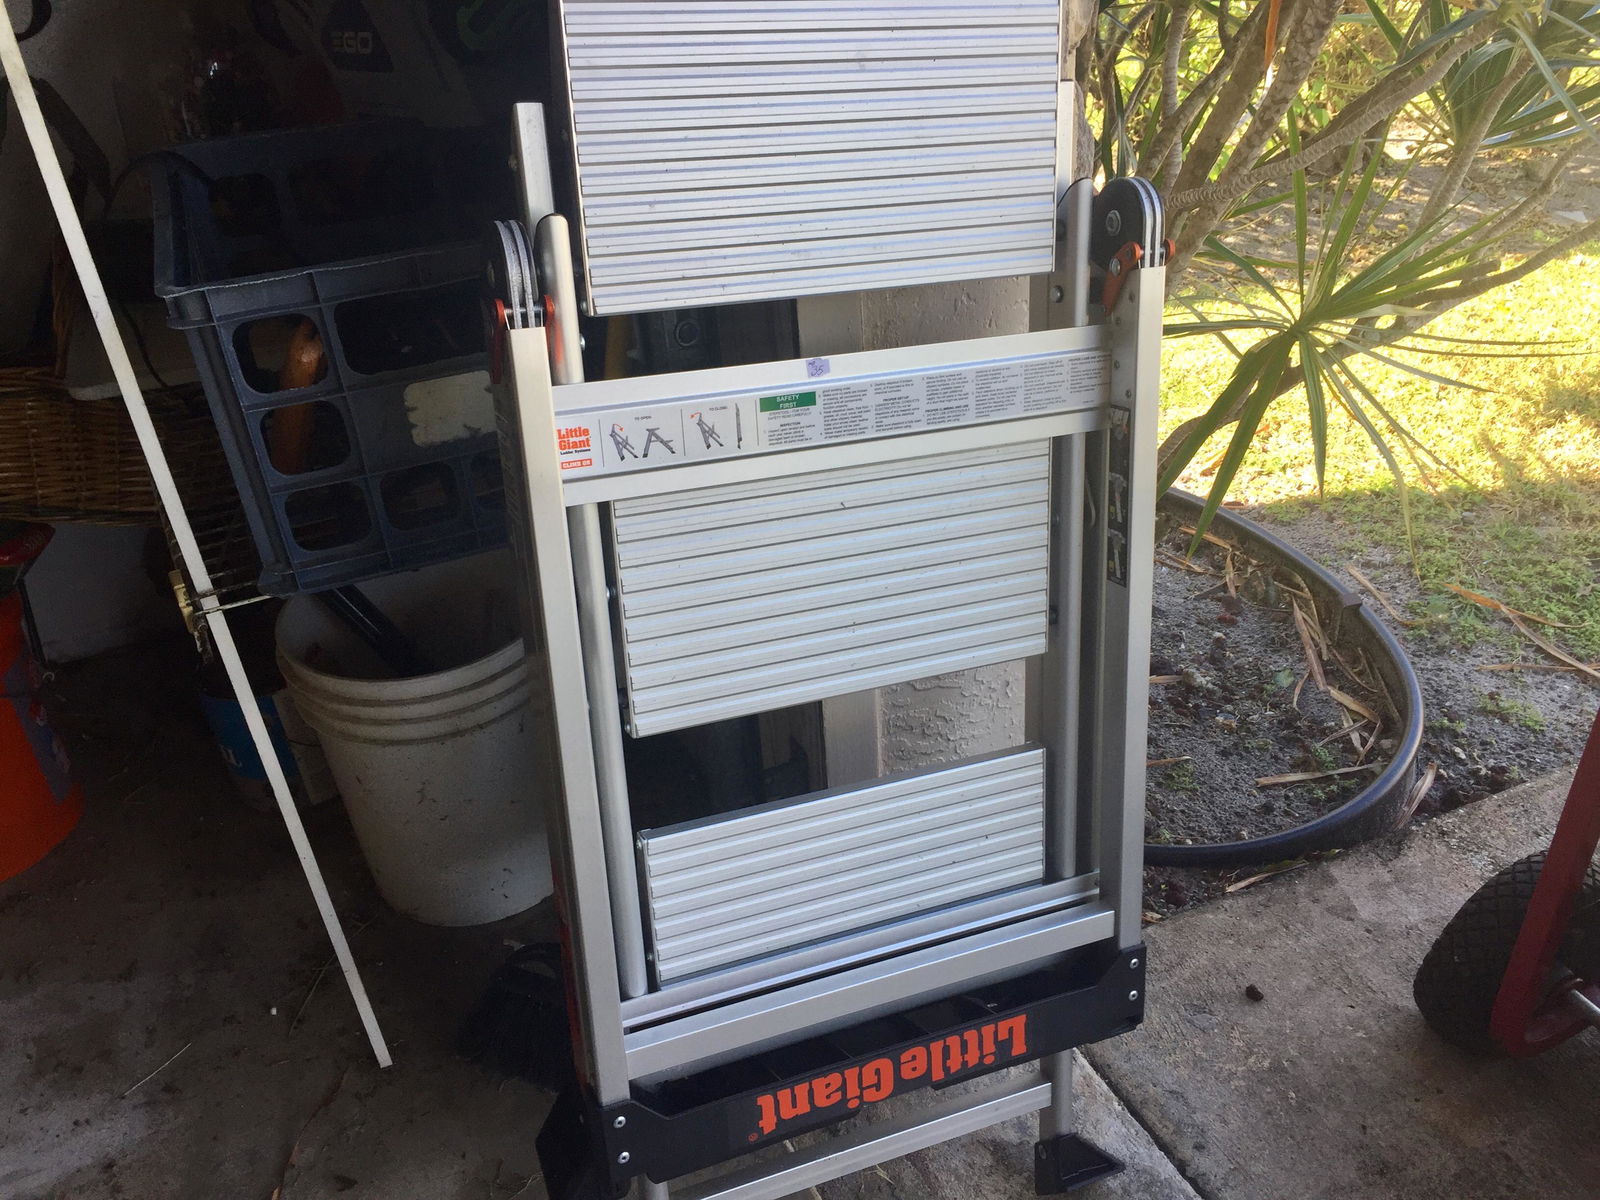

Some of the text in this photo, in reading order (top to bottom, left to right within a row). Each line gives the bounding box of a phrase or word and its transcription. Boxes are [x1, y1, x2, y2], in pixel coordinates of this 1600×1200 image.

[331, 31, 372, 54] EGO
[776, 394, 800, 402] SAFETY
[780, 402, 797, 410] FIRST
[556, 426, 590, 440] Little
[559, 437, 591, 451] Giant
[755, 1014, 1028, 1136] Little Giant
